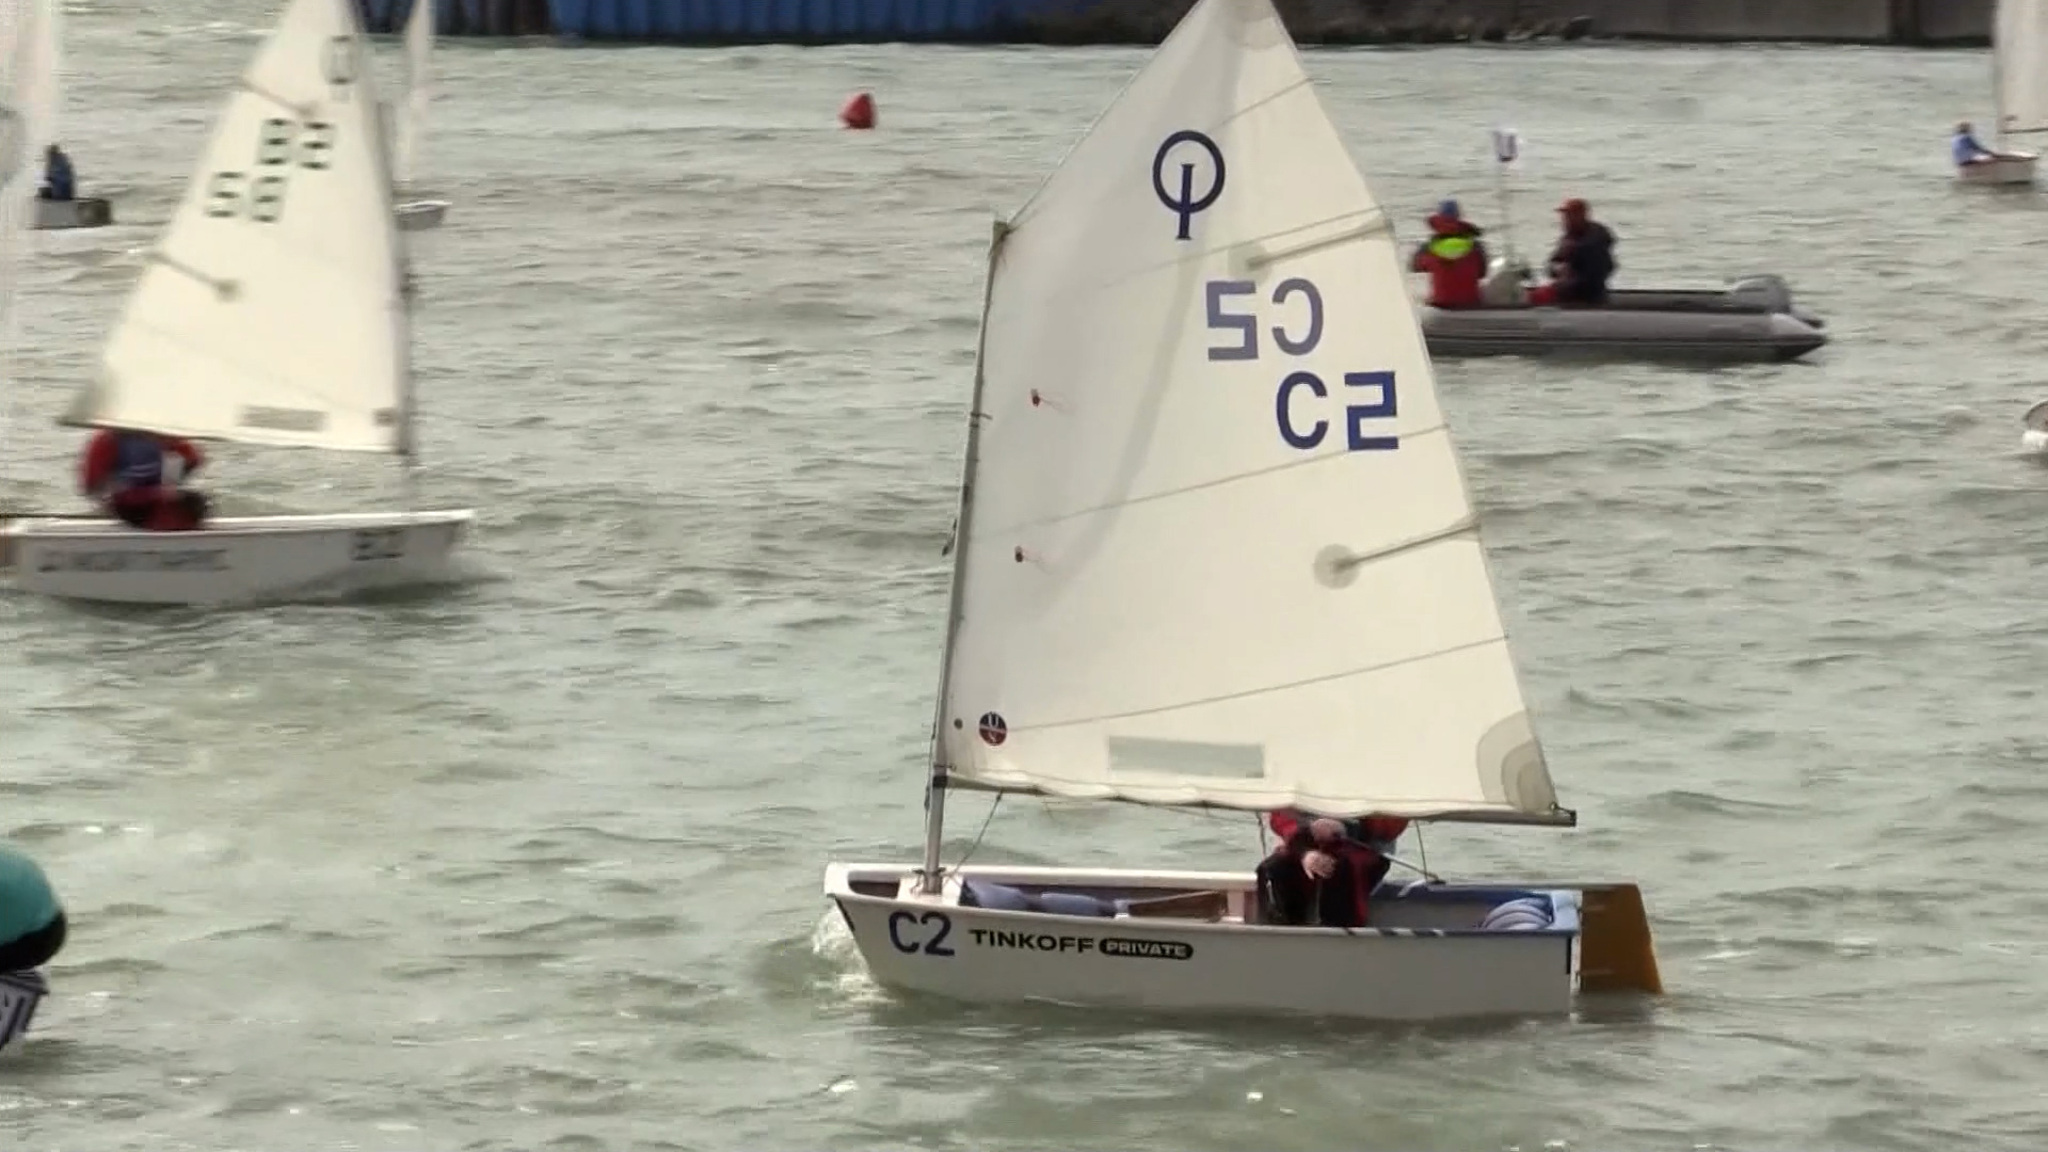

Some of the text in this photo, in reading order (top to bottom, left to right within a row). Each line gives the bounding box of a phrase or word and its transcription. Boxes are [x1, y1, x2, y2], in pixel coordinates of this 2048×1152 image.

[1277, 371, 1399, 450] C2
[888, 911, 1186, 959] C2 TINKOFF PRIVATE
